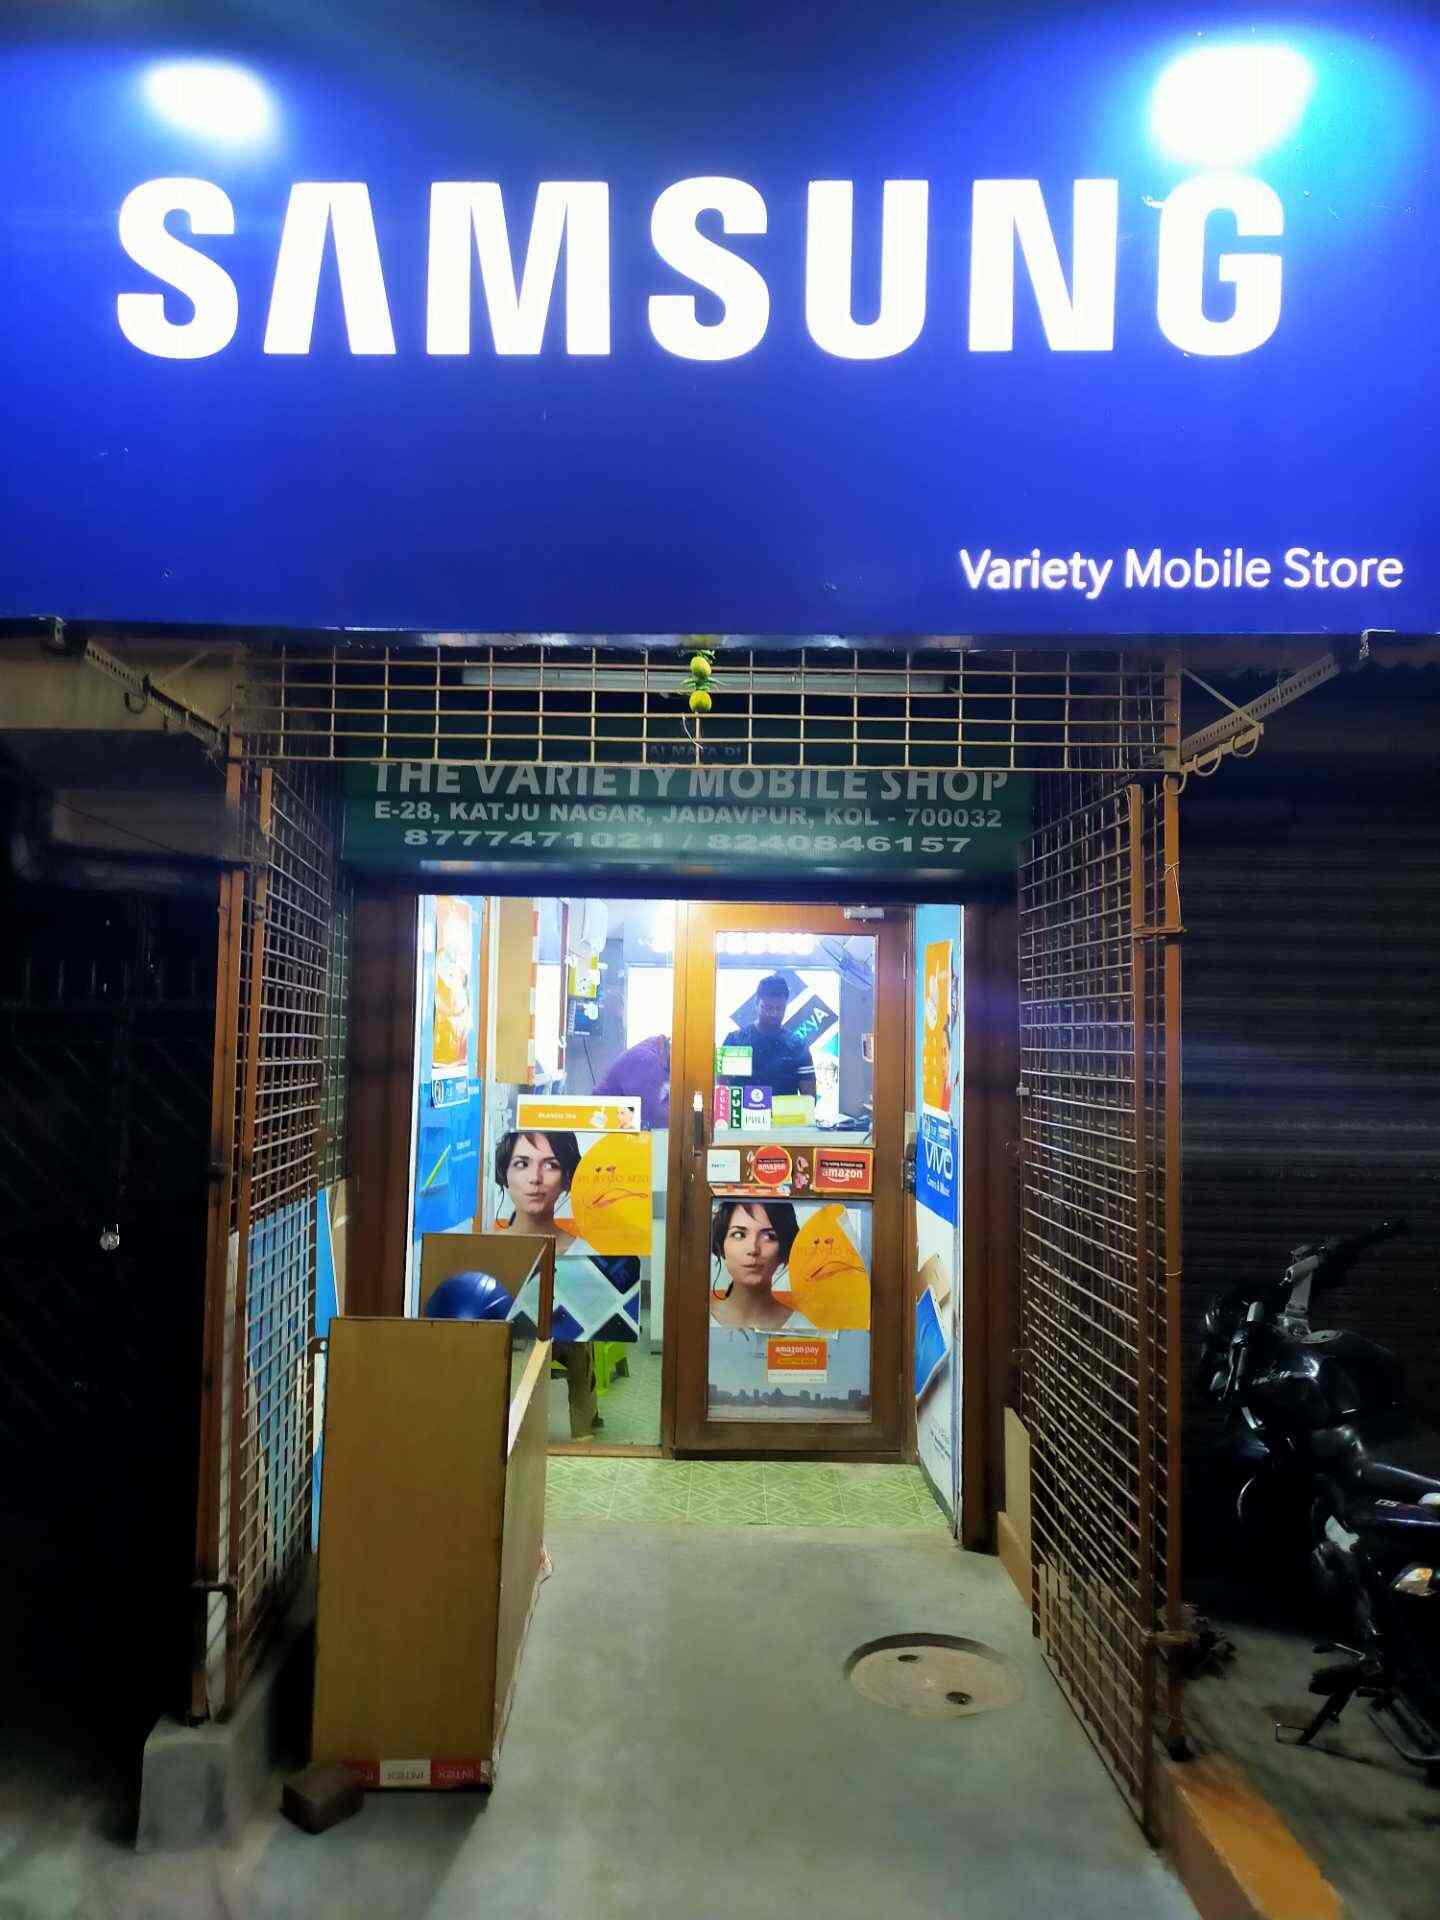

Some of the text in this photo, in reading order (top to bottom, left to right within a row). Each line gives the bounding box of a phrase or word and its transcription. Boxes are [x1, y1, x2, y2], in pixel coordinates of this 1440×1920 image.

[116, 174, 1286, 362] SAMSUNG
[958, 547, 1404, 600] Variety Mobile Store
[371, 761, 1009, 802] THE VARIETY MOBILE SHOP
[373, 800, 441, 823] E-28,
[450, 802, 541, 822] KATJU
[550, 804, 653, 825] NAGAR,
[662, 805, 815, 829] JADAVPUR,
[824, 807, 880, 826] KOL
[904, 807, 1003, 828] 700032
[403, 829, 666, 848] 8777471021
[707, 833, 973, 854] 8240846157
[732, 1088, 742, 1129] PULL
[821, 1167, 863, 1179] amazon
